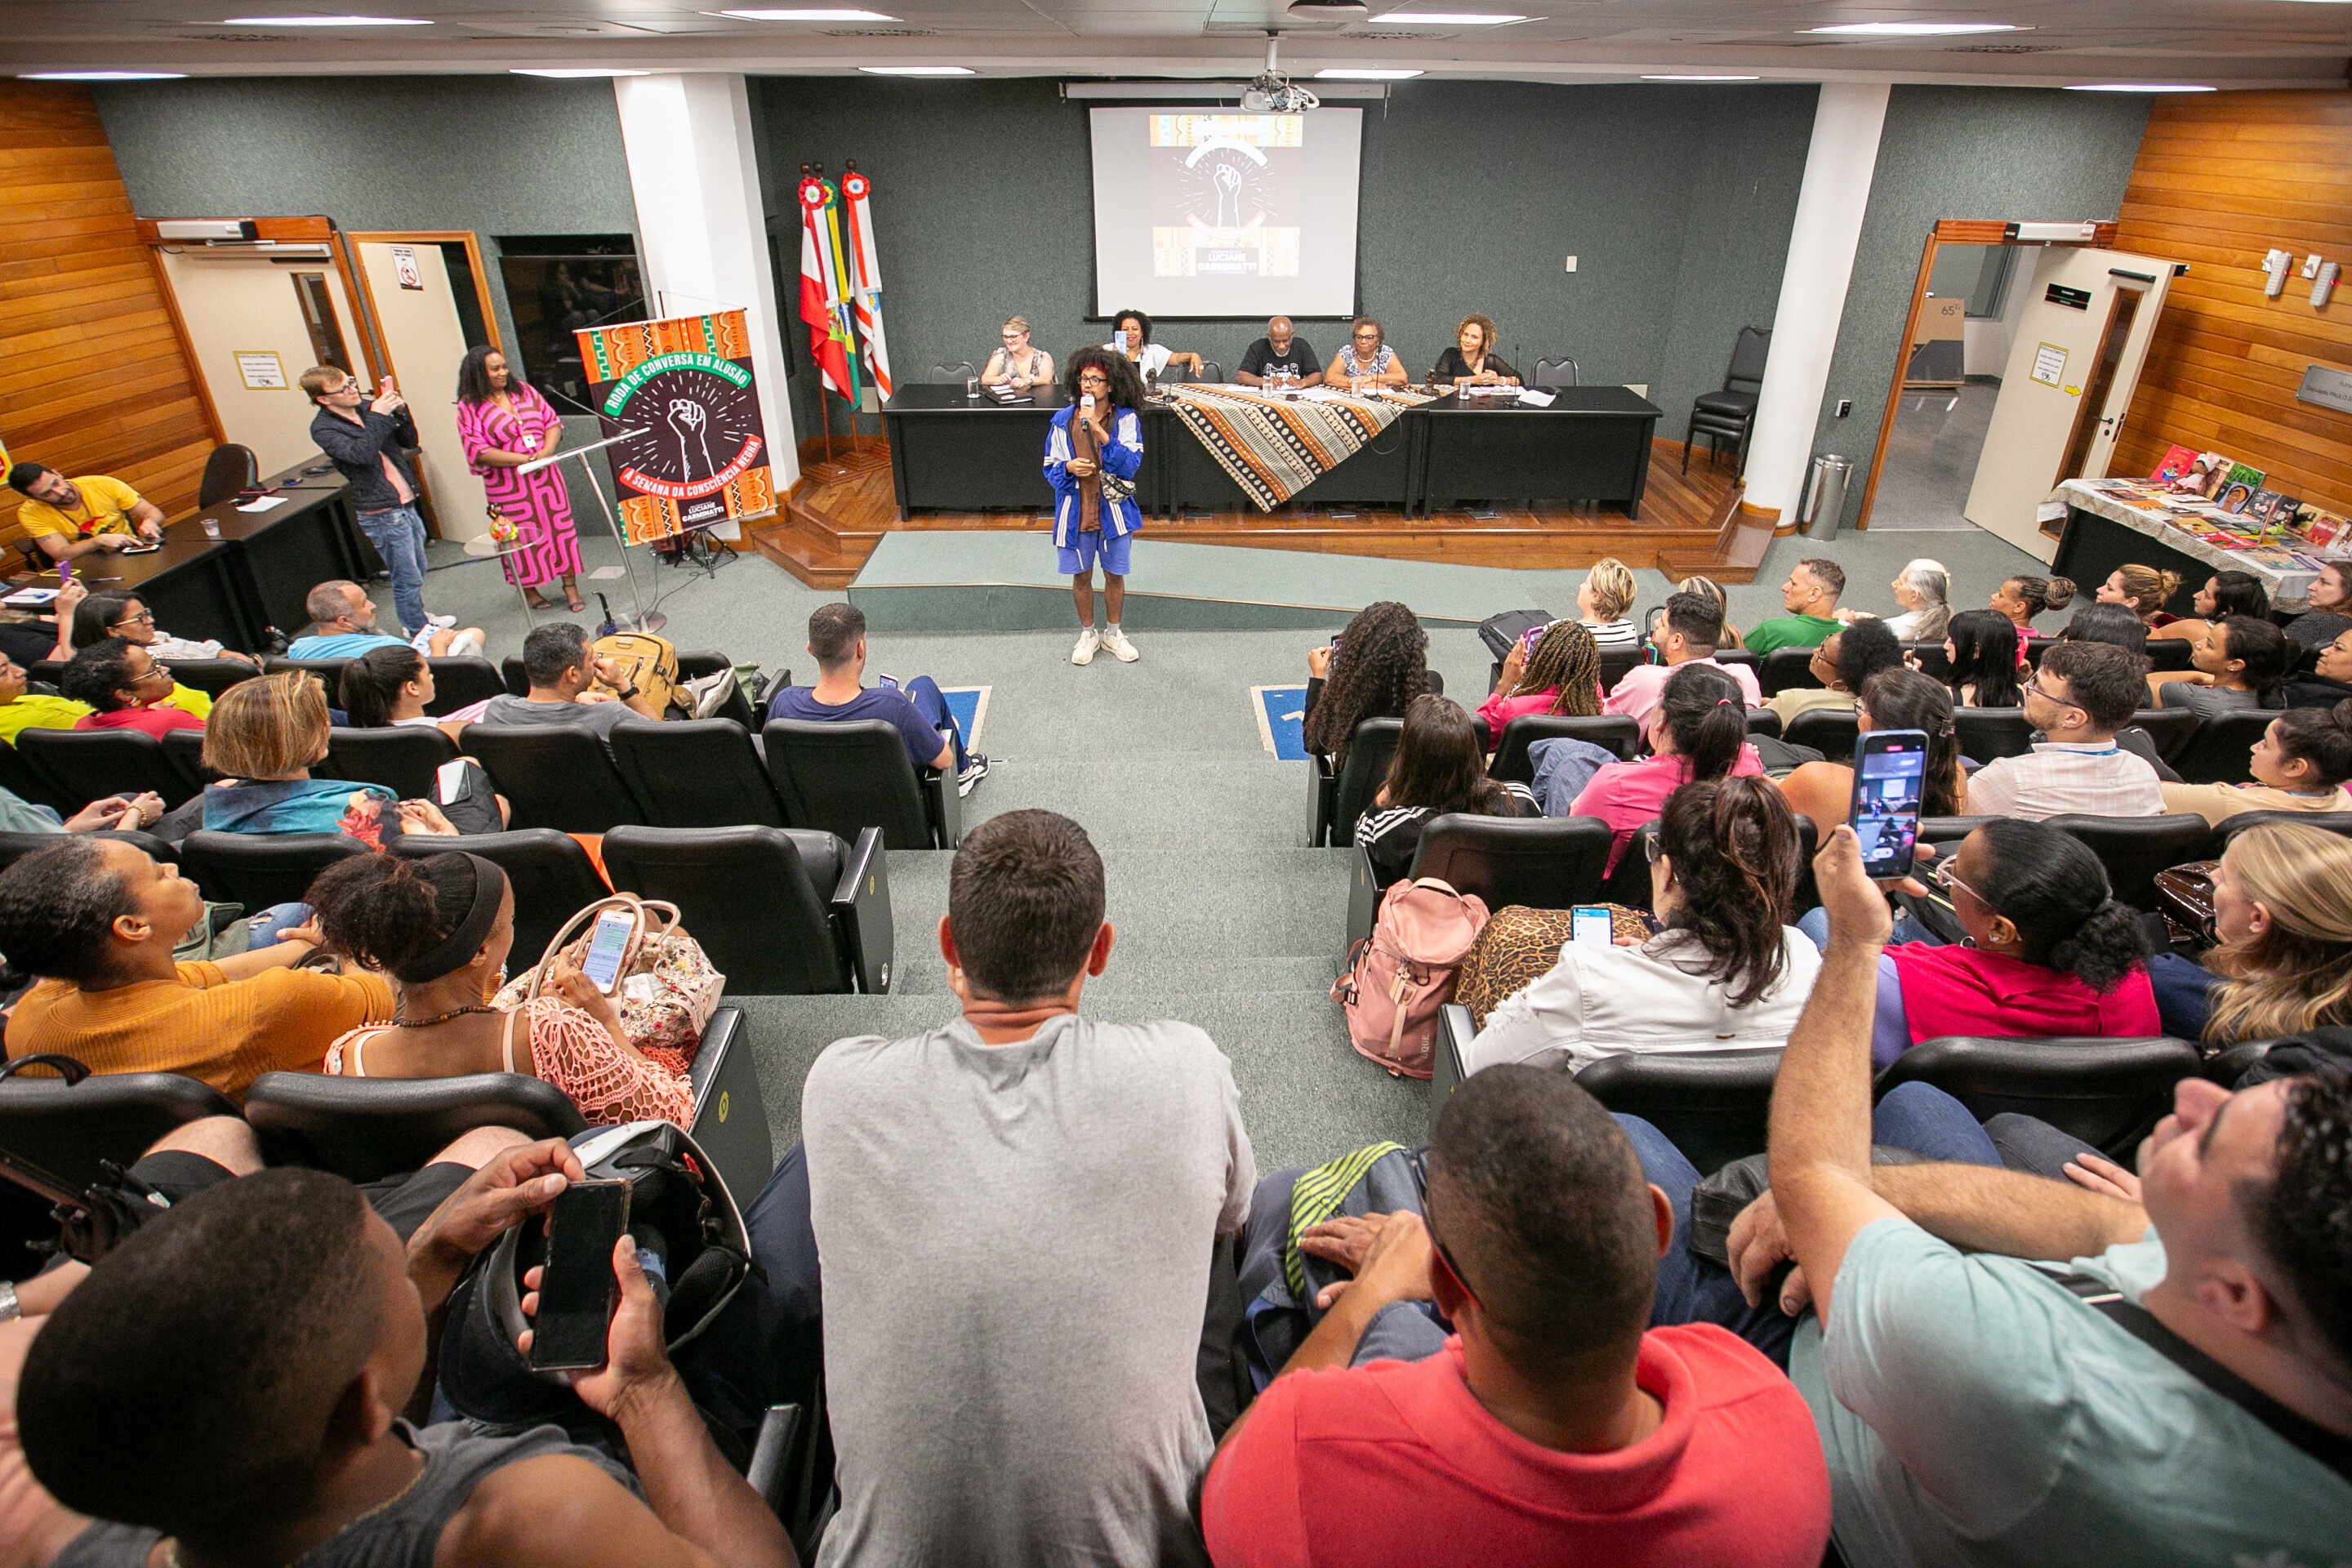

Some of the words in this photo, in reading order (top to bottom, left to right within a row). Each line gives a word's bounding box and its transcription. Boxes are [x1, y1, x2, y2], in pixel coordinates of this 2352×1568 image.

[1208, 253, 1247, 261] LUCIANE
[1197, 261, 1257, 270] CARMINATTI
[606, 382, 631, 408] RODA
[627, 370, 643, 385] DE
[641, 354, 693, 376] CONVERSA
[697, 354, 711, 367] EM
[712, 359, 747, 385] ALUSÃO
[2329, 391, 2348, 400] PAULO
[624, 469, 635, 480] A
[632, 475, 669, 496] SEMANA
[671, 487, 684, 497] DA
[687, 465, 741, 497] CONSCIÊNCIA
[737, 440, 760, 468] NEGRA
[682, 506, 724, 522] CARMINATTI
[688, 501, 715, 514] LUCIANE
